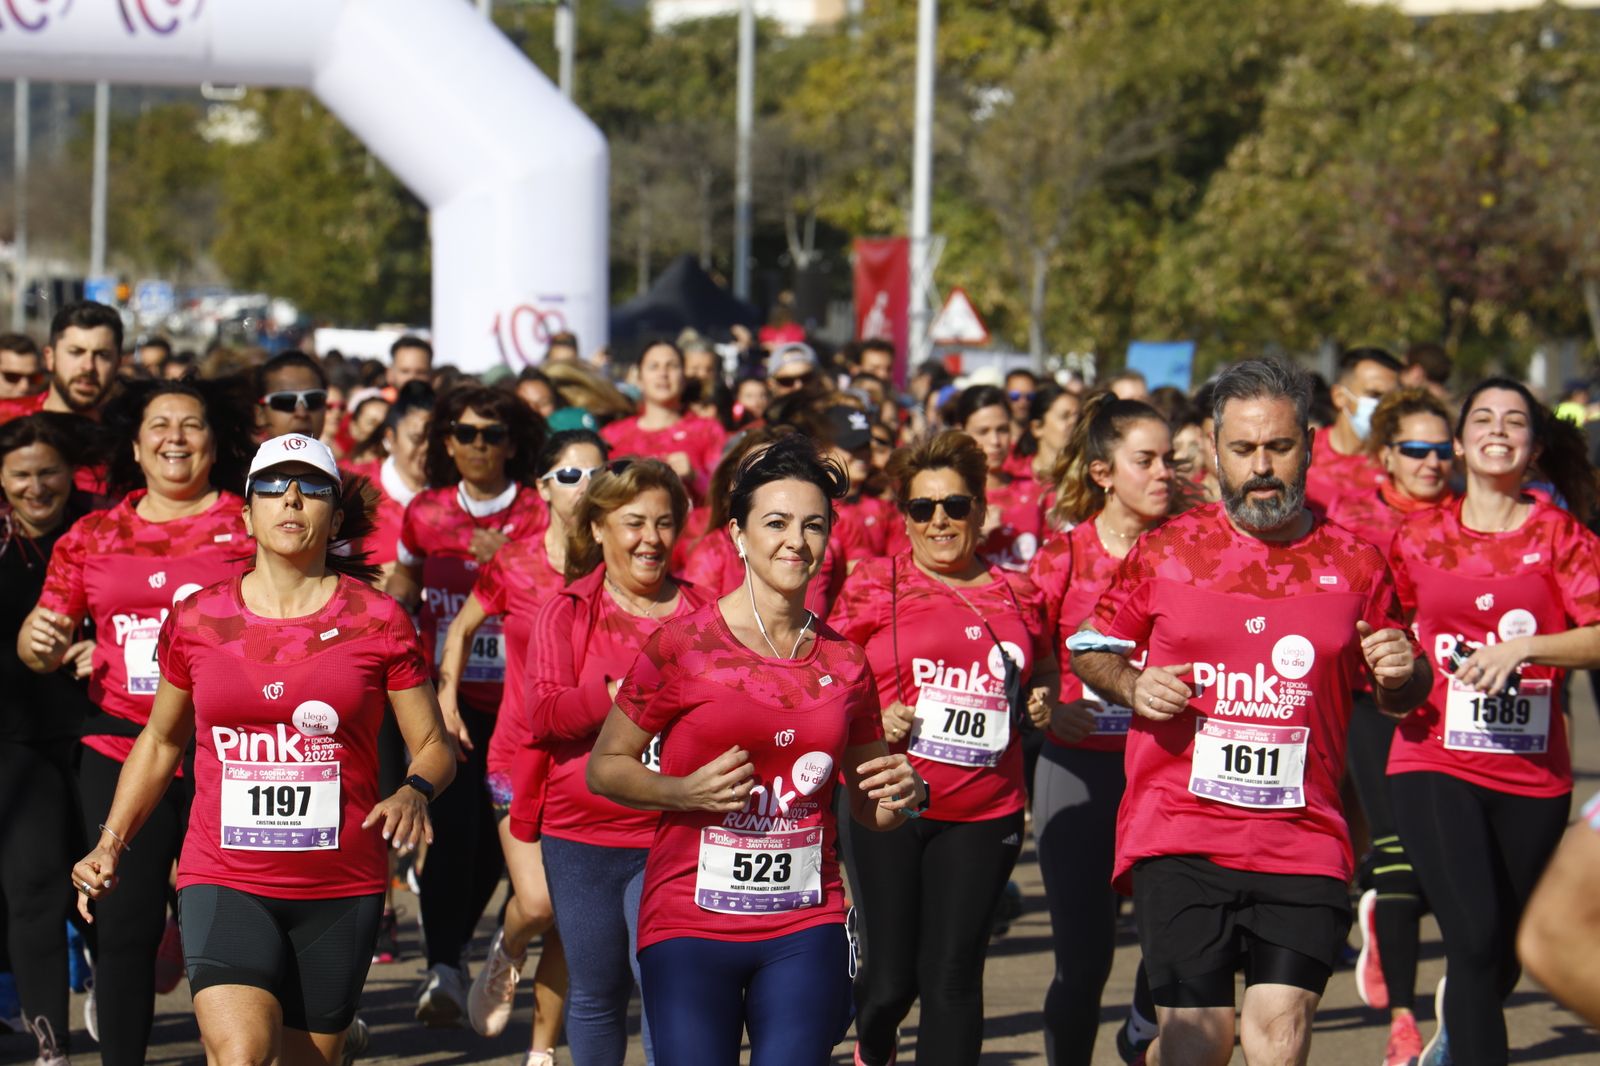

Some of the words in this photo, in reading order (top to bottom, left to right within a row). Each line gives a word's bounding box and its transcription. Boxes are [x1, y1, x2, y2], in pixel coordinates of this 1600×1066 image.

[428, 587, 467, 613] Pin
[1281, 658, 1289, 666] tu
[912, 658, 989, 694] Pink
[1193, 662, 1278, 703] Pink
[1214, 699, 1294, 719] RUNNING
[1279, 694, 1306, 706] 2022
[1470, 697, 1530, 725] 1589
[303, 711, 328, 722] Llegó
[942, 707, 986, 738] 708
[212, 723, 304, 762] Pink
[304, 750, 335, 762] 2022
[1221, 744, 1280, 776] 1611
[801, 772, 809, 783] tu
[247, 785, 311, 817] 1197
[743, 776, 796, 816] nk
[722, 811, 798, 831] RUNNING
[709, 832, 729, 843] Pink
[733, 853, 792, 883] 523
